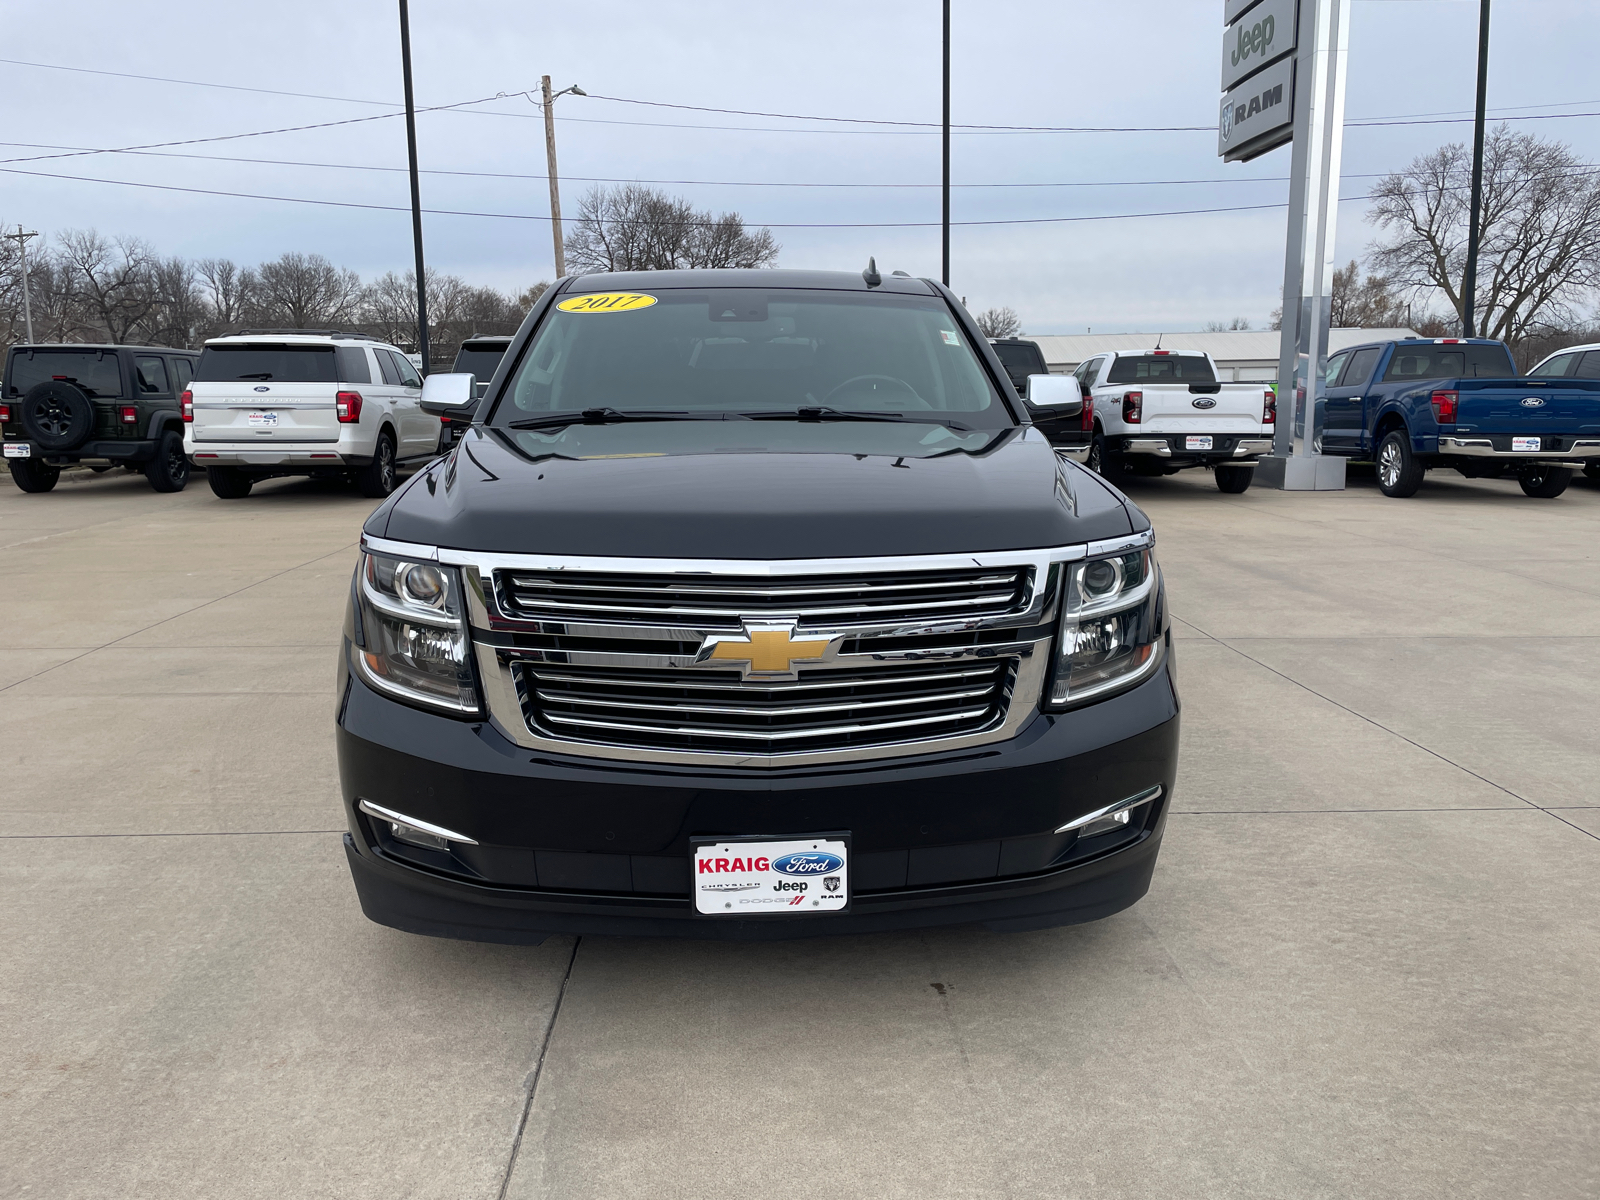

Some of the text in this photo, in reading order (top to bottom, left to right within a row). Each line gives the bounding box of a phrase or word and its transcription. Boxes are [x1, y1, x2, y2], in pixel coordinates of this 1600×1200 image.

[1231, 14, 1275, 67] Jeep
[1234, 83, 1283, 126] RAM
[571, 296, 643, 310] 2017
[698, 856, 830, 874] KRAIG Ford
[773, 880, 809, 893] Jeep
